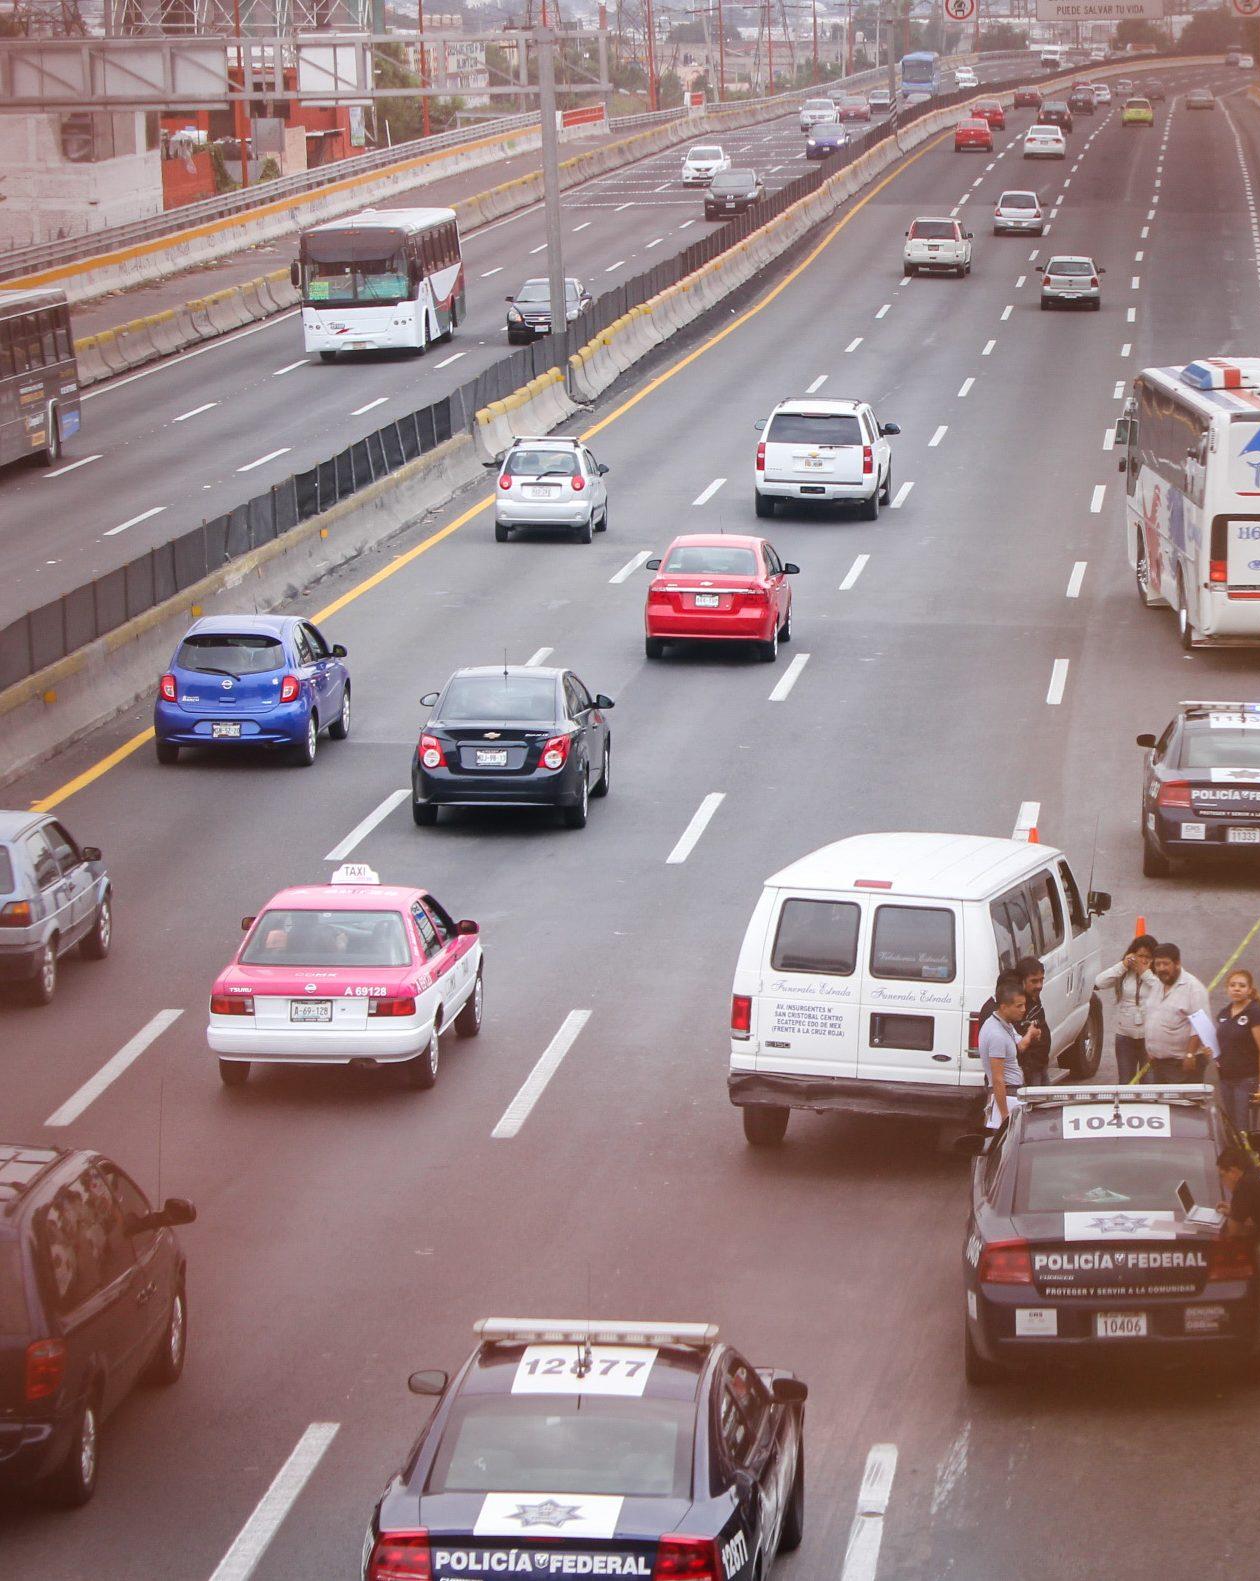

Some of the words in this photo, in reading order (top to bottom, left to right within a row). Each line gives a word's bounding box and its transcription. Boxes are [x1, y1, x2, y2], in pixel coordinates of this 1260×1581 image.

[1056, 5, 1081, 15] PUEDE
[1084, 5, 1113, 15] SALVAR
[1116, 5, 1125, 14] TU
[1126, 4, 1144, 14] VIDA
[1191, 789, 1241, 801] POLICÍA
[1231, 831, 1257, 841] 11333
[344, 866, 366, 876] TAXI
[344, 987, 353, 996] A
[355, 986, 387, 996] 69128
[771, 980, 816, 994] Funerales
[818, 982, 852, 997] Estrada
[871, 987, 916, 1002] Funerales
[919, 989, 952, 1004] Estrada
[294, 1005, 329, 1016] A-69-128
[786, 1004, 826, 1013] INSURGENTES
[777, 1018, 807, 1027] ECATEPEC
[787, 1011, 819, 1020] CRISTOBAL
[820, 1014, 844, 1022] CENTRO
[771, 1026, 796, 1034] (FRENTE
[810, 1028, 827, 1036] CRUZ
[827, 1029, 845, 1038] ROJA)
[1068, 1116, 1165, 1131] 10406
[1034, 1251, 1113, 1271] POLICÍA
[1127, 1251, 1208, 1268] FEDERAL
[1045, 1288, 1088, 1296] PROTEGER
[1097, 1287, 1126, 1295] SERVIR
[1135, 1286, 1146, 1294] LA
[1148, 1284, 1196, 1294] COMUNIDAD
[1103, 1318, 1142, 1334] 10406
[525, 1358, 648, 1379] 12877
[722, 1530, 749, 1580] 12877
[435, 1548, 533, 1573] POLICÍA
[549, 1553, 651, 1576] FEDERAL
